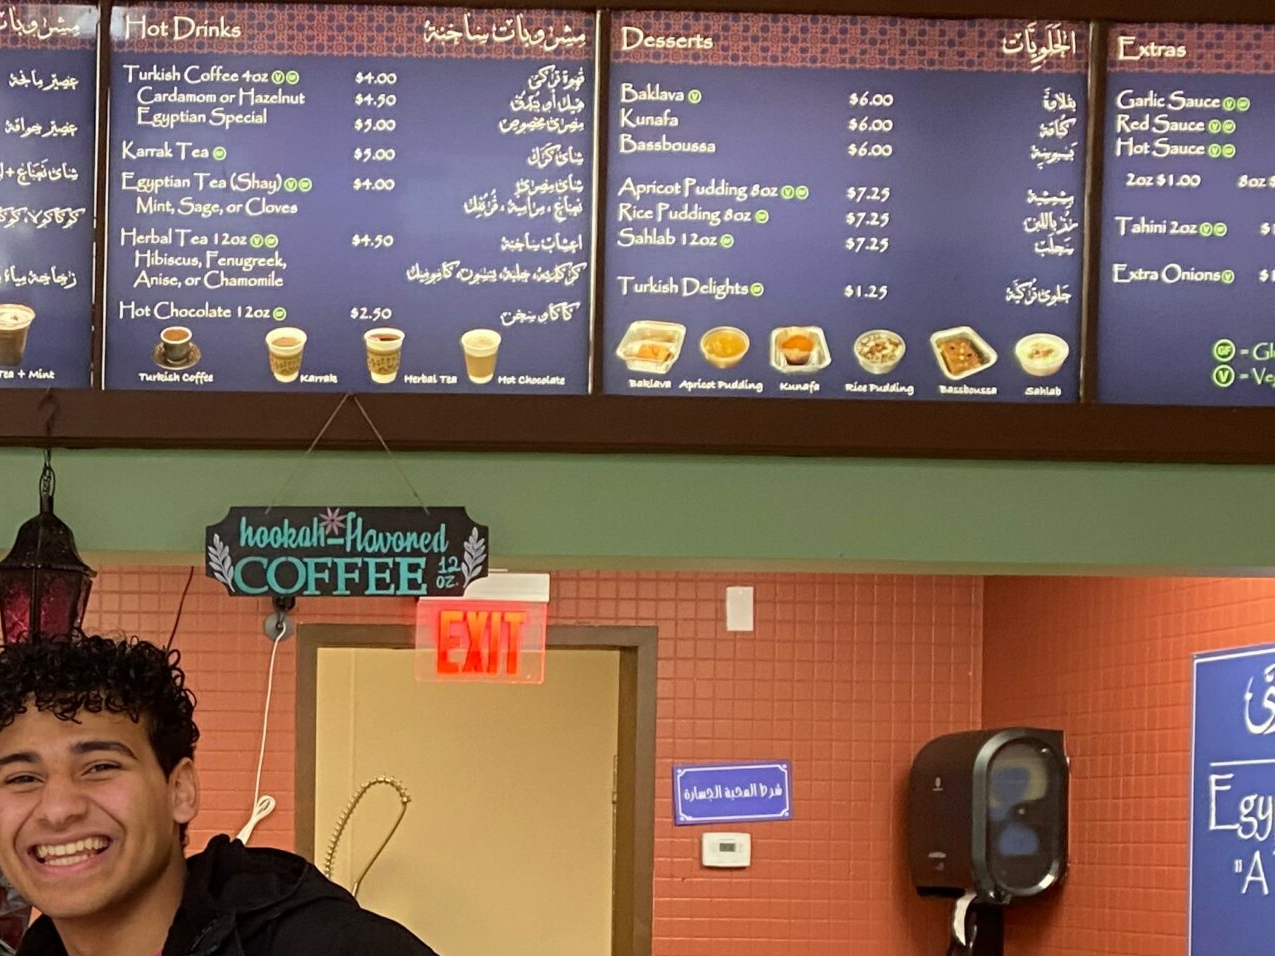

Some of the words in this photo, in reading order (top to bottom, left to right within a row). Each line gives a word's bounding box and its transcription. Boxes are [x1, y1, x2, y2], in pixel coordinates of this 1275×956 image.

[125, 14, 169, 39] Hot
[174, 16, 241, 40] Drinks
[621, 27, 713, 51] Desserts
[1117, 36, 1187, 60] Extras
[123, 64, 181, 83] Turkish
[184, 65, 239, 83] Coffee
[241, 70, 269, 82] 4oz
[355, 72, 397, 85] $4.00
[137, 86, 217, 105] Cardamom
[220, 93, 236, 103] or
[239, 88, 306, 106] Hazelnut
[620, 83, 685, 103] Baklava
[849, 91, 894, 107] $6.00
[1116, 90, 1165, 109] Garlic
[1167, 90, 1221, 110] Sauce
[137, 107, 206, 129] Egyptian
[209, 107, 268, 130] Special
[620, 108, 678, 129] Kunafa
[1116, 114, 1150, 133] Red
[1152, 114, 1205, 134] Sauce
[122, 140, 173, 160] Karrak
[176, 142, 209, 160] Tea
[620, 134, 716, 154] Bassboussa
[1116, 137, 1150, 157] Hot
[1152, 137, 1205, 158] Sauce
[121, 172, 191, 194] Egyptian
[194, 172, 226, 191] Tea
[230, 172, 283, 194] (Shay)
[618, 177, 681, 200] Apricot
[684, 178, 747, 201] Pudding
[750, 184, 778, 197] 8oz
[1126, 173, 1153, 186] 2oz
[1157, 174, 1201, 188] $1.00
[136, 197, 175, 215] Mint,
[177, 197, 224, 218] Sage,
[226, 203, 243, 213] or
[245, 197, 298, 216] Cloves
[618, 203, 653, 222] Rice
[657, 203, 721, 226] Pudding
[724, 209, 751, 222] 8oz
[1114, 216, 1166, 236] Tahini
[1170, 221, 1197, 234] 2oz
[120, 227, 172, 246] Herbal
[175, 228, 208, 247] Tea
[214, 233, 247, 246] 12oz
[617, 228, 675, 247] Sahlab
[681, 234, 717, 246] 12oz
[135, 249, 203, 268] Hibiscus,
[205, 250, 287, 271] Fenugreek,
[133, 270, 182, 288] Anise,
[184, 277, 201, 286] or
[203, 270, 284, 289] Chamomile
[1112, 263, 1159, 283] Extra
[1161, 263, 1221, 284] Onions
[617, 277, 678, 296] Turkish
[682, 277, 748, 300] Delights
[844, 285, 888, 300] $1.25
[119, 301, 151, 319] Hot
[153, 301, 232, 320] Chocolate
[237, 306, 271, 318] 12oz
[350, 307, 392, 321] $2.50
[717, 380, 763, 392] Pudding
[780, 381, 820, 392] Kunafa
[240, 511, 448, 554] hookah-flavored
[438, 556, 461, 574] 12
[234, 556, 427, 596] COFFEE
[437, 610, 526, 674] EXIT
